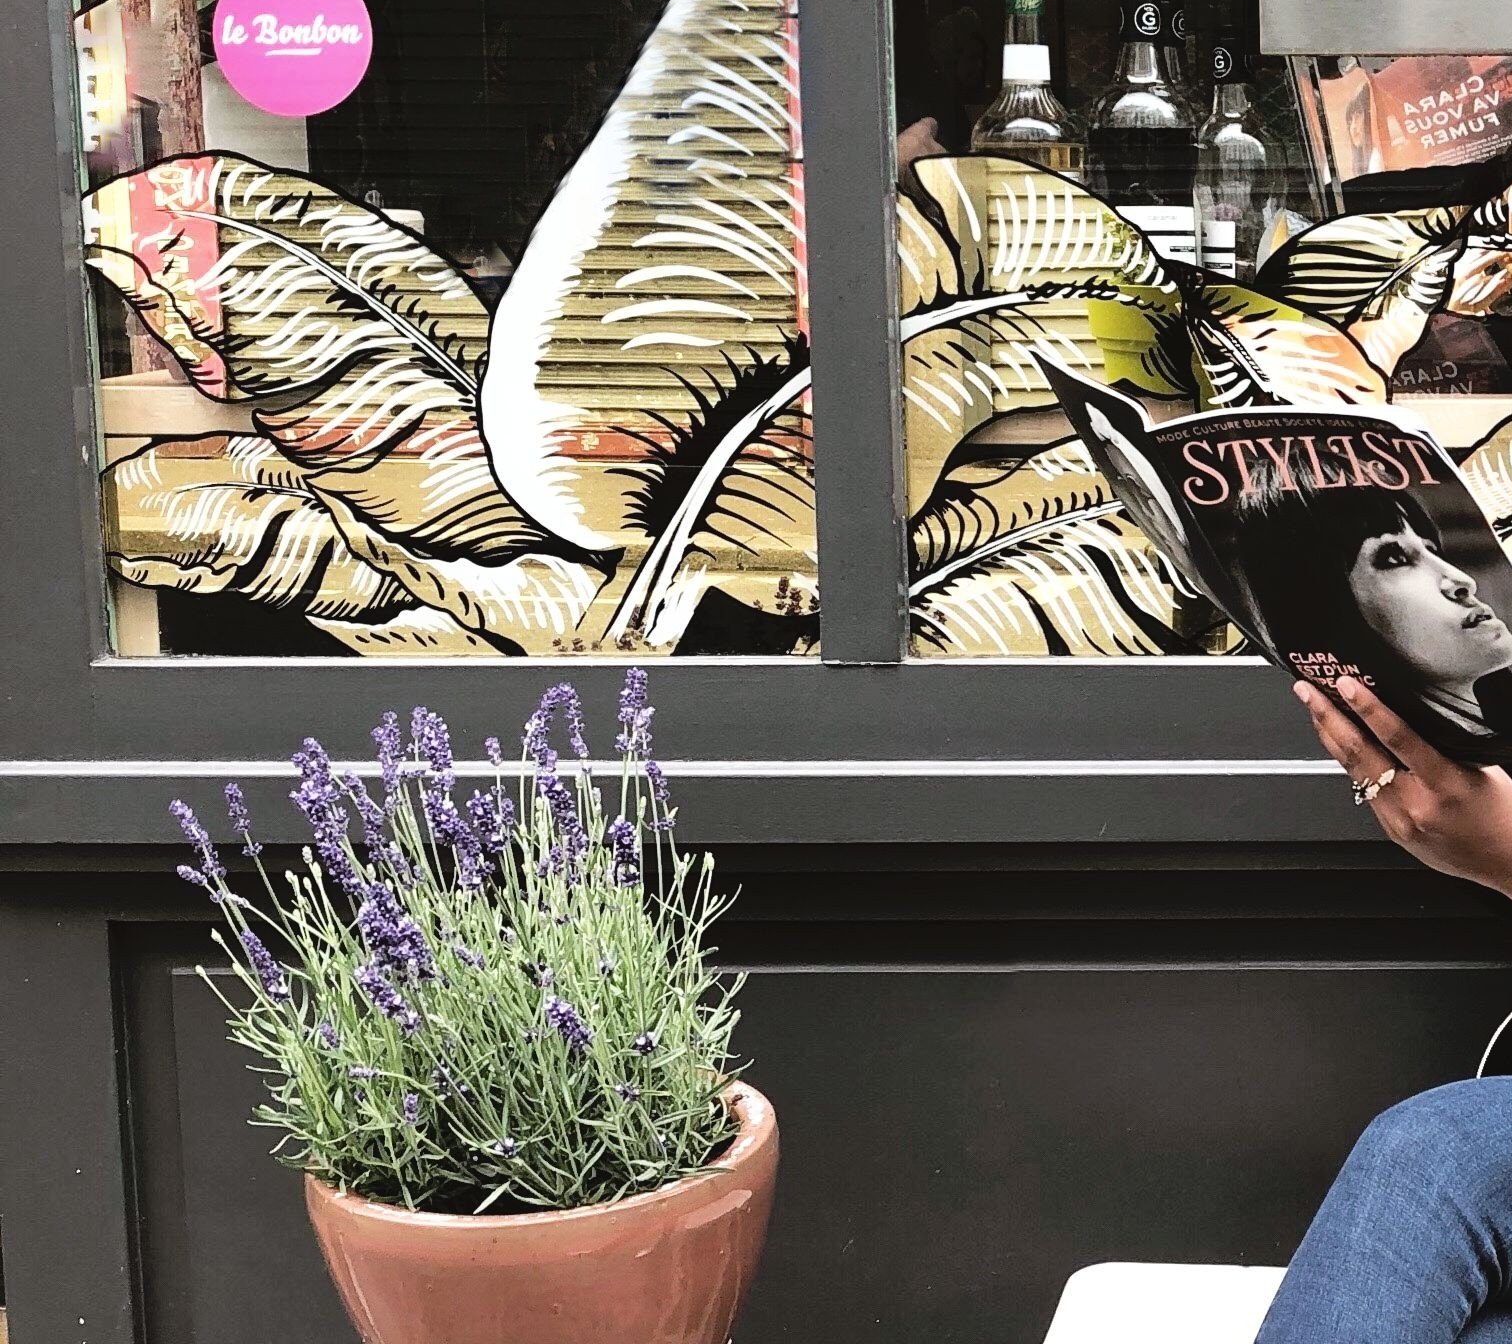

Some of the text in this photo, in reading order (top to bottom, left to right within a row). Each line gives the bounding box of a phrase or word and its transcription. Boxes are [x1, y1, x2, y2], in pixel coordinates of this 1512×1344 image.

[221, 13, 363, 46] le Bonbon
[1182, 431, 1441, 505] STYLIST
[1288, 652, 1339, 664] CLARA
[1322, 664, 1360, 676] D'UN
